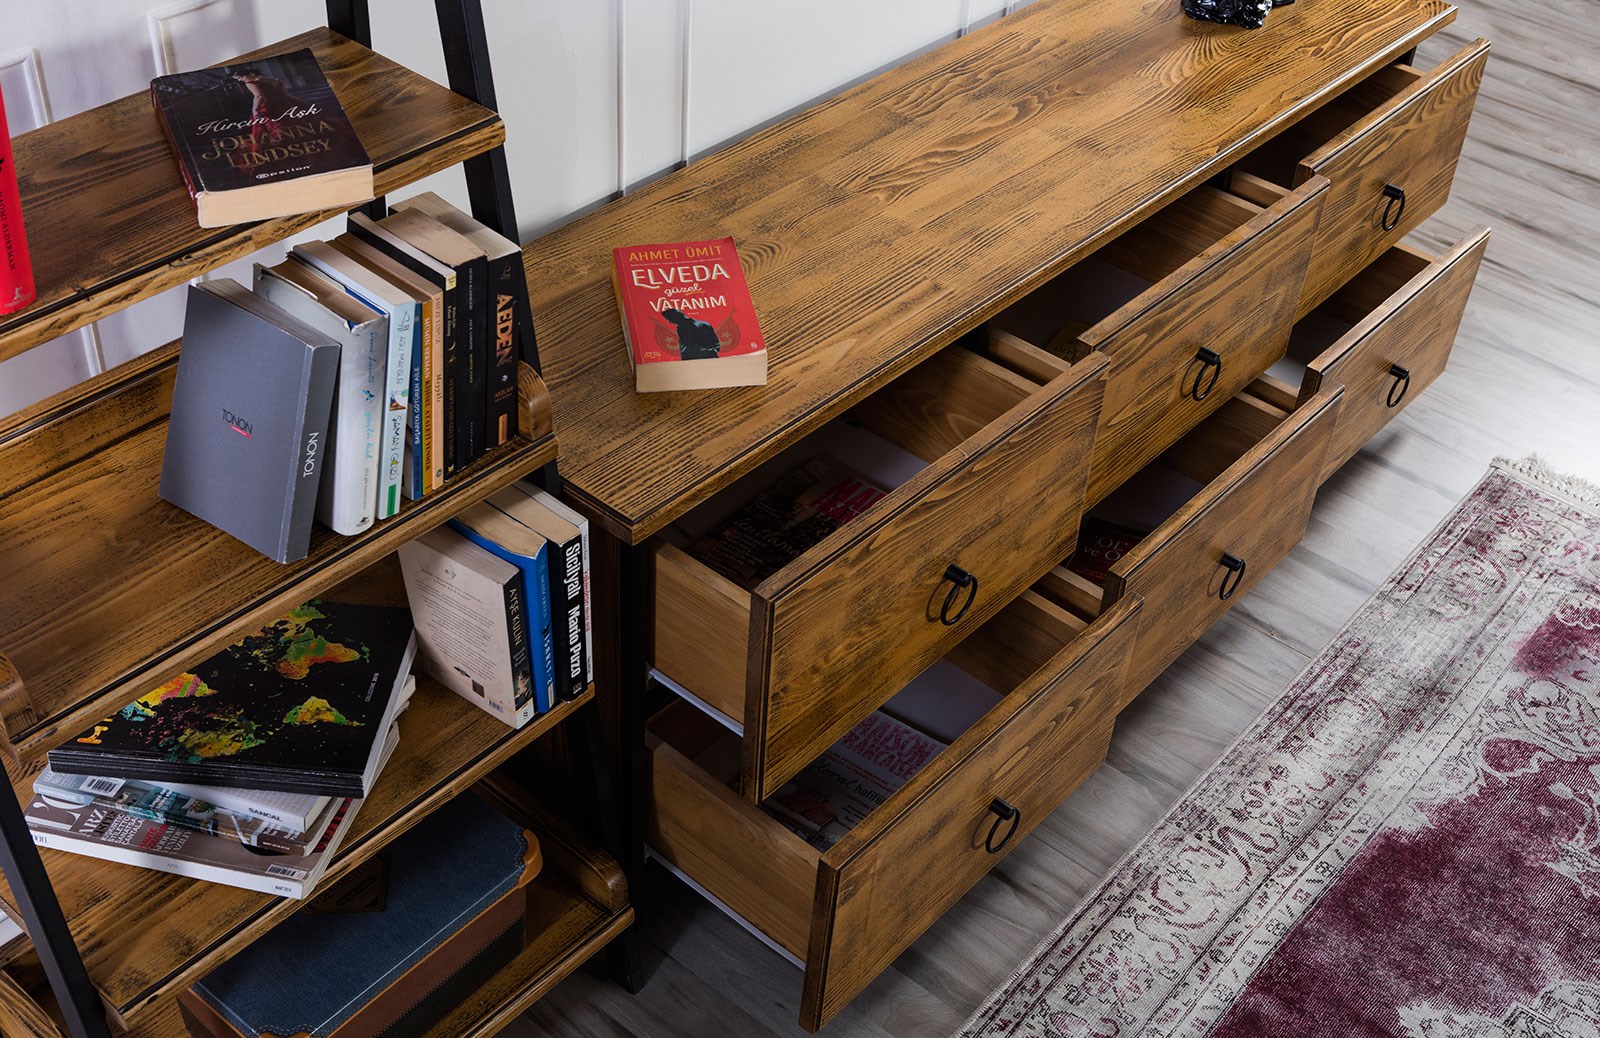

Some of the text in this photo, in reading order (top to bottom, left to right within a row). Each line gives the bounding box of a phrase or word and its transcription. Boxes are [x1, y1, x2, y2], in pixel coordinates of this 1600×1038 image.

[271, 103, 322, 123] Aşk
[202, 120, 334, 160] JOHANNA
[229, 138, 332, 168] LINDSEY
[629, 245, 722, 262] AHMET ÜMİT
[631, 263, 731, 289] ELVEDA
[663, 282, 702, 297] güzel
[649, 295, 727, 312] VATANIM
[496, 294, 514, 367] AEDEN
[413, 382, 421, 412] GÖTÜREN
[222, 408, 253, 434] TONON
[413, 413, 421, 445] BAŞARIYA
[303, 432, 319, 478] TONON
[509, 588, 518, 613] AYŞE
[511, 612, 523, 646] KULİN
[567, 604, 581, 648] Mario
[569, 644, 581, 679] Puzo
[248, 807, 282, 821] SANCAL
[139, 827, 157, 848] HAUTE
